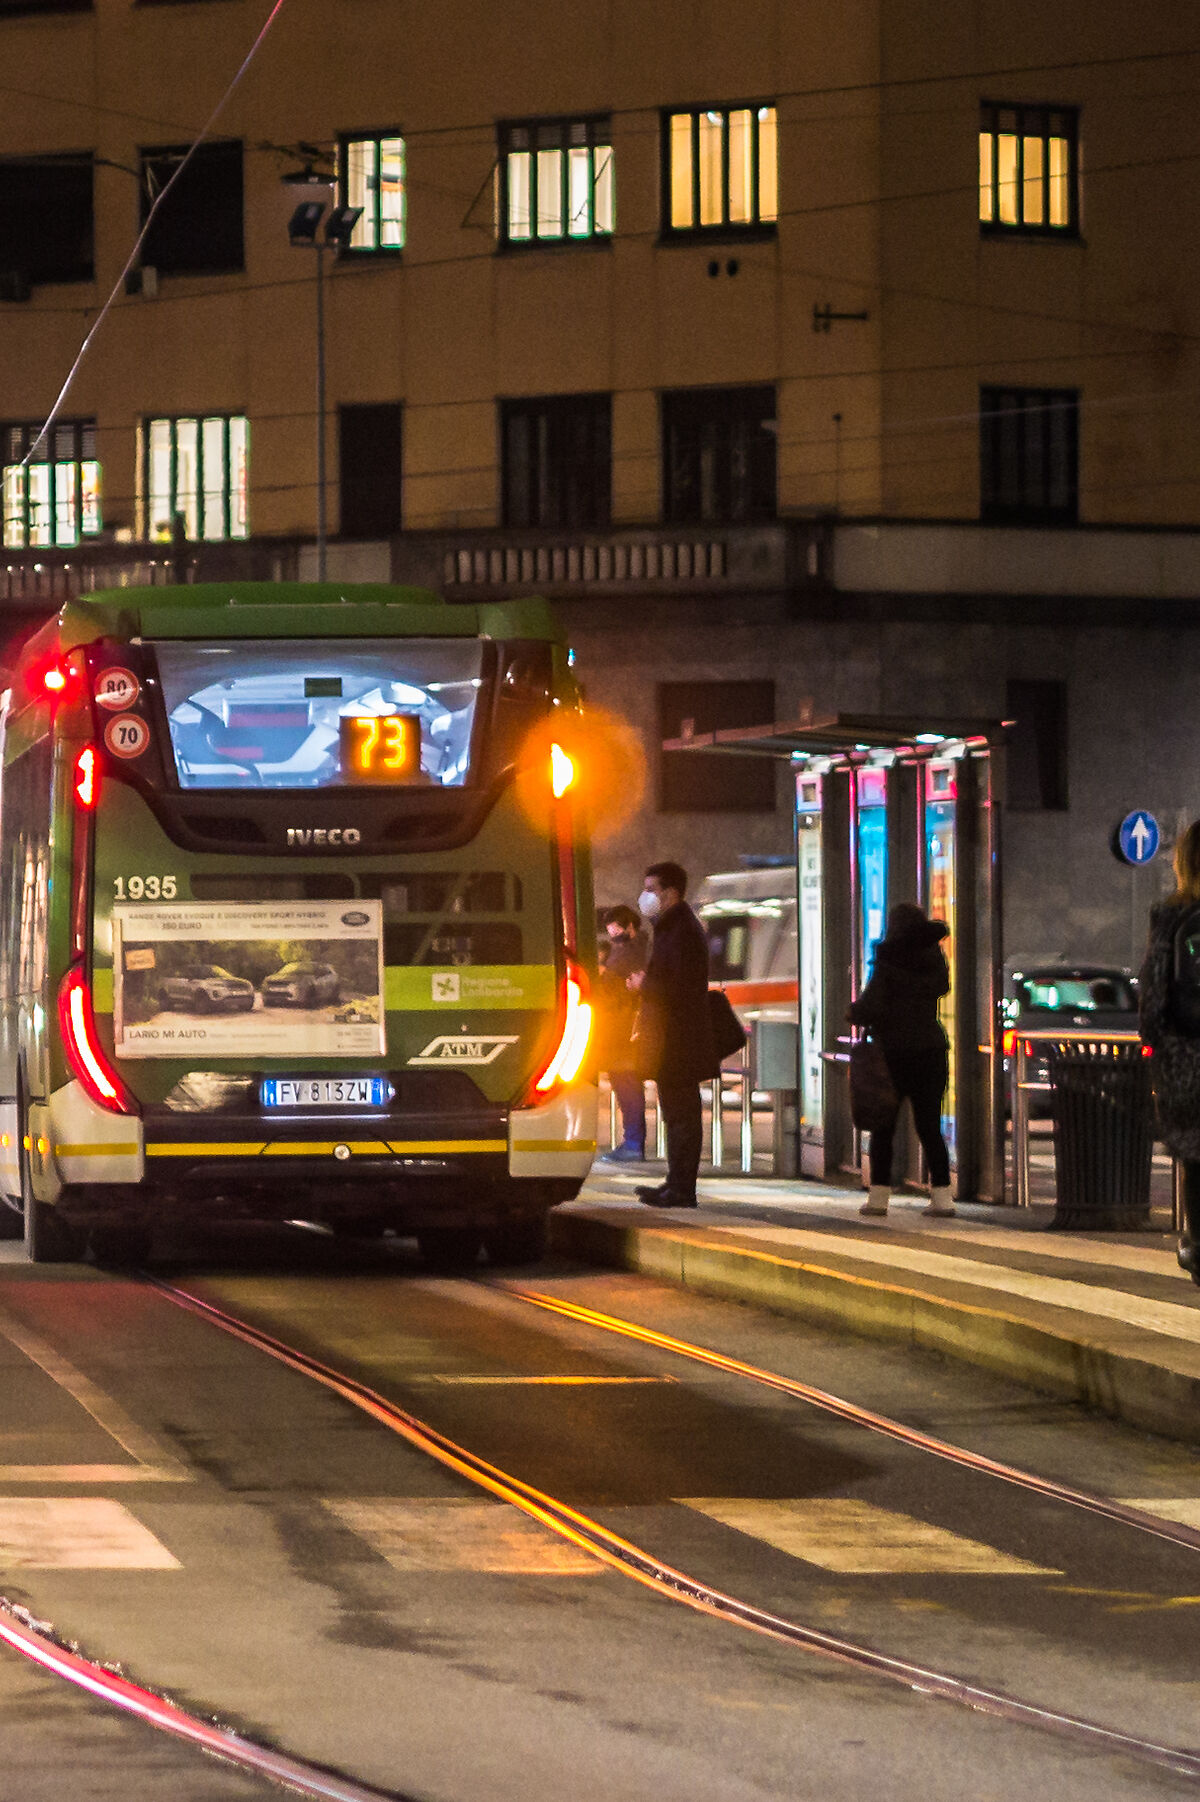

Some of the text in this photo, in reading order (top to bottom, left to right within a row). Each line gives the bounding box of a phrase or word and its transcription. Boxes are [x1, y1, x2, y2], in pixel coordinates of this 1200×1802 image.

[118, 727, 139, 745] 70
[356, 717, 407, 769] 73
[286, 828, 361, 846] IVECO
[112, 875, 178, 900] 1935
[178, 921, 202, 930] EURO
[129, 1030, 159, 1039] LARIO
[178, 1030, 207, 1039] AUTO
[440, 1042, 484, 1057] ATM
[280, 1081, 368, 1103] FV 813ZW
